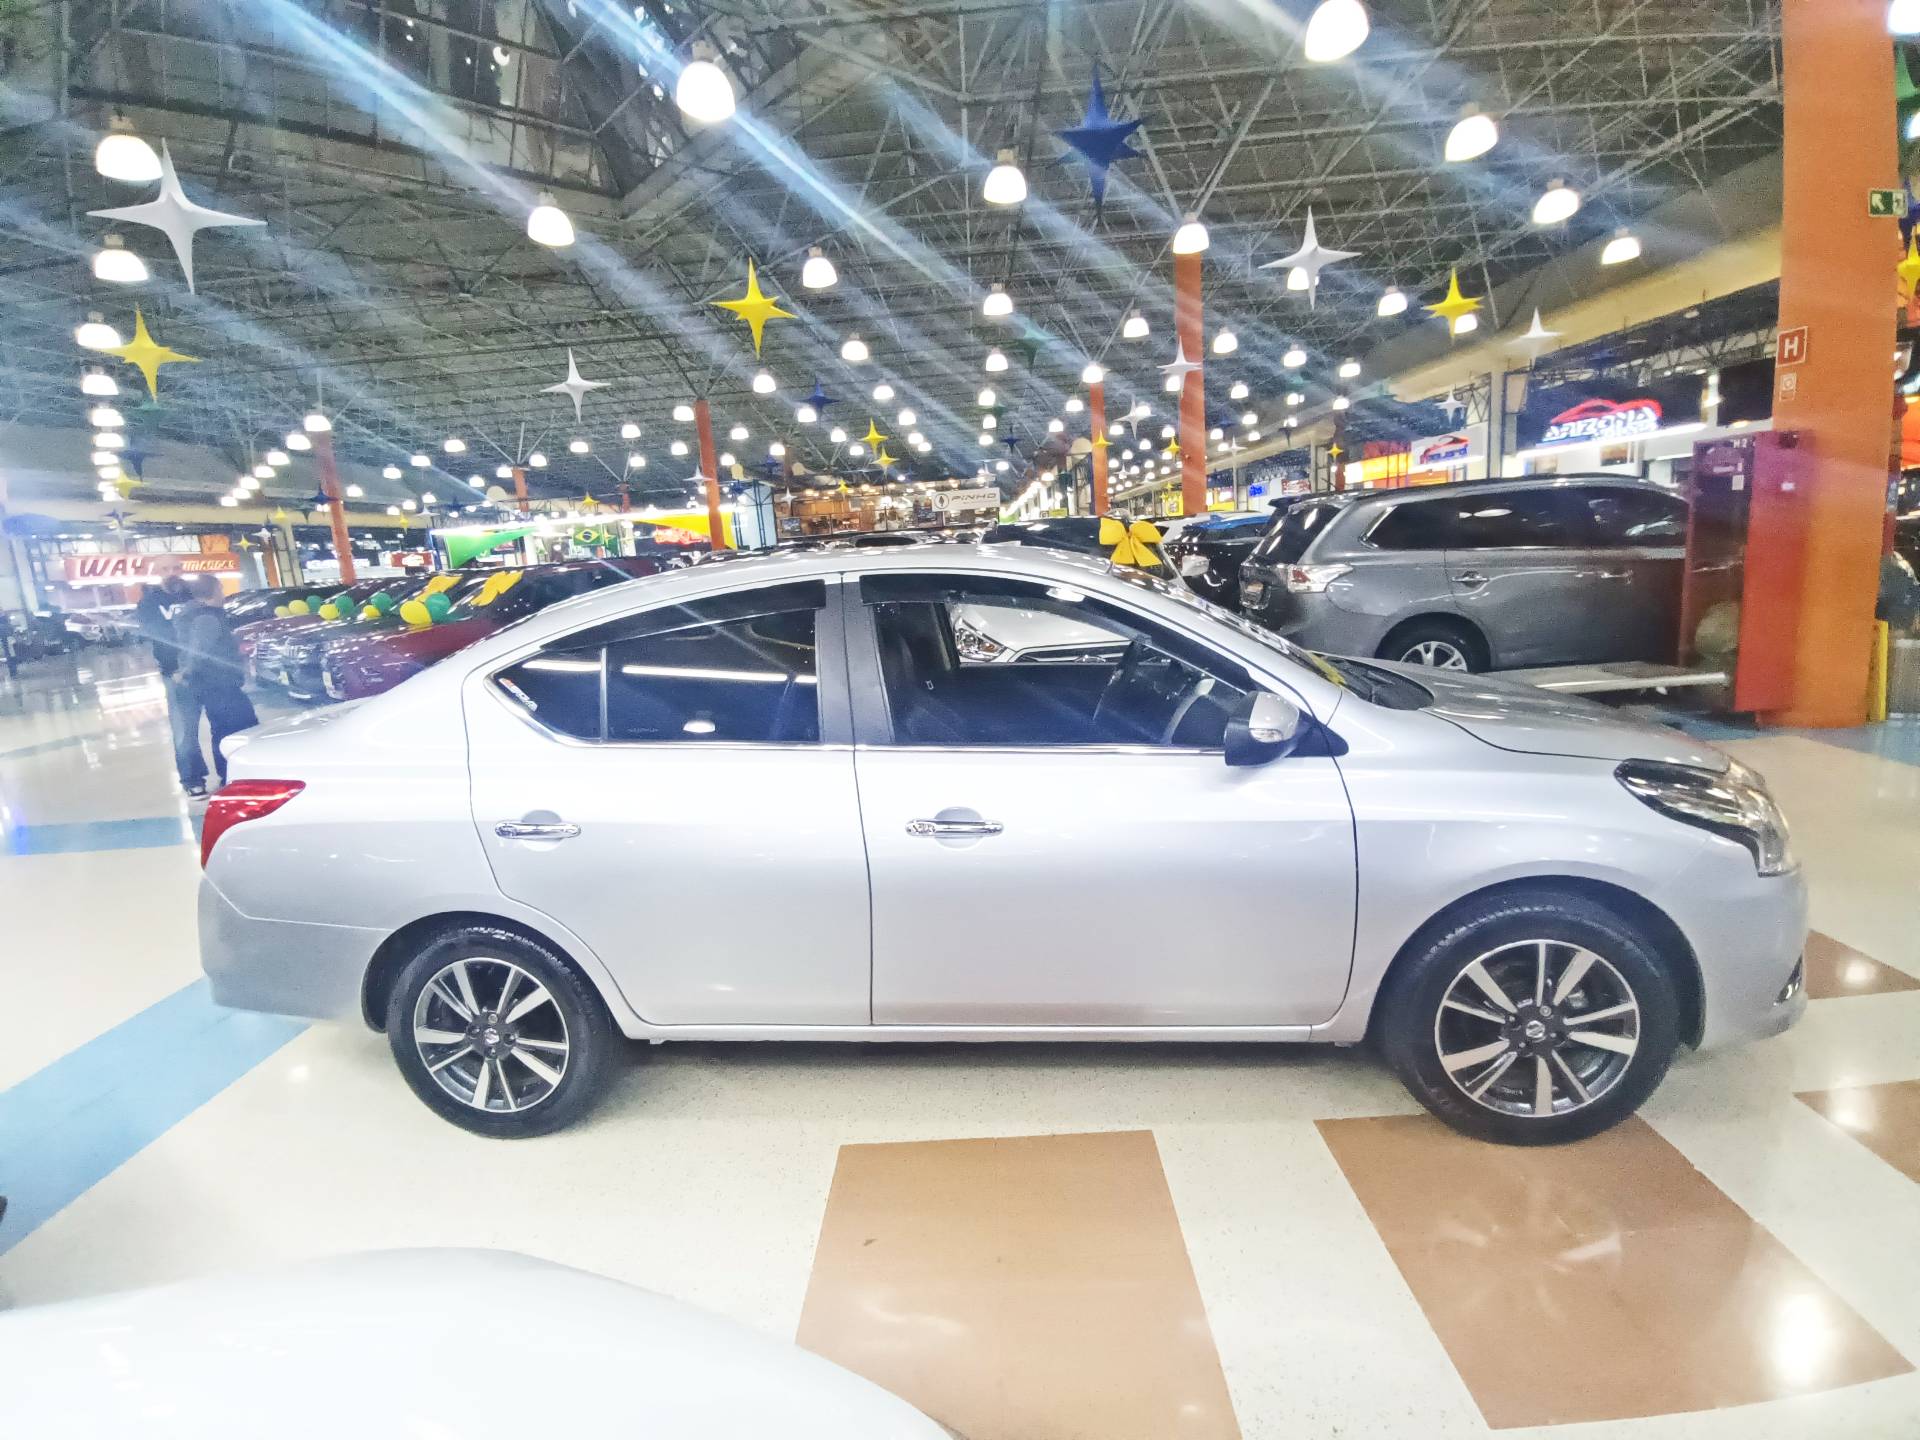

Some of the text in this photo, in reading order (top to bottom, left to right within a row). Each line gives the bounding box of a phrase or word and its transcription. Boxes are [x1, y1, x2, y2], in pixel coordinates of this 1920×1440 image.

[1783, 336, 1799, 359] H
[951, 493, 997, 501] PINHO
[75, 556, 147, 579] WAY
